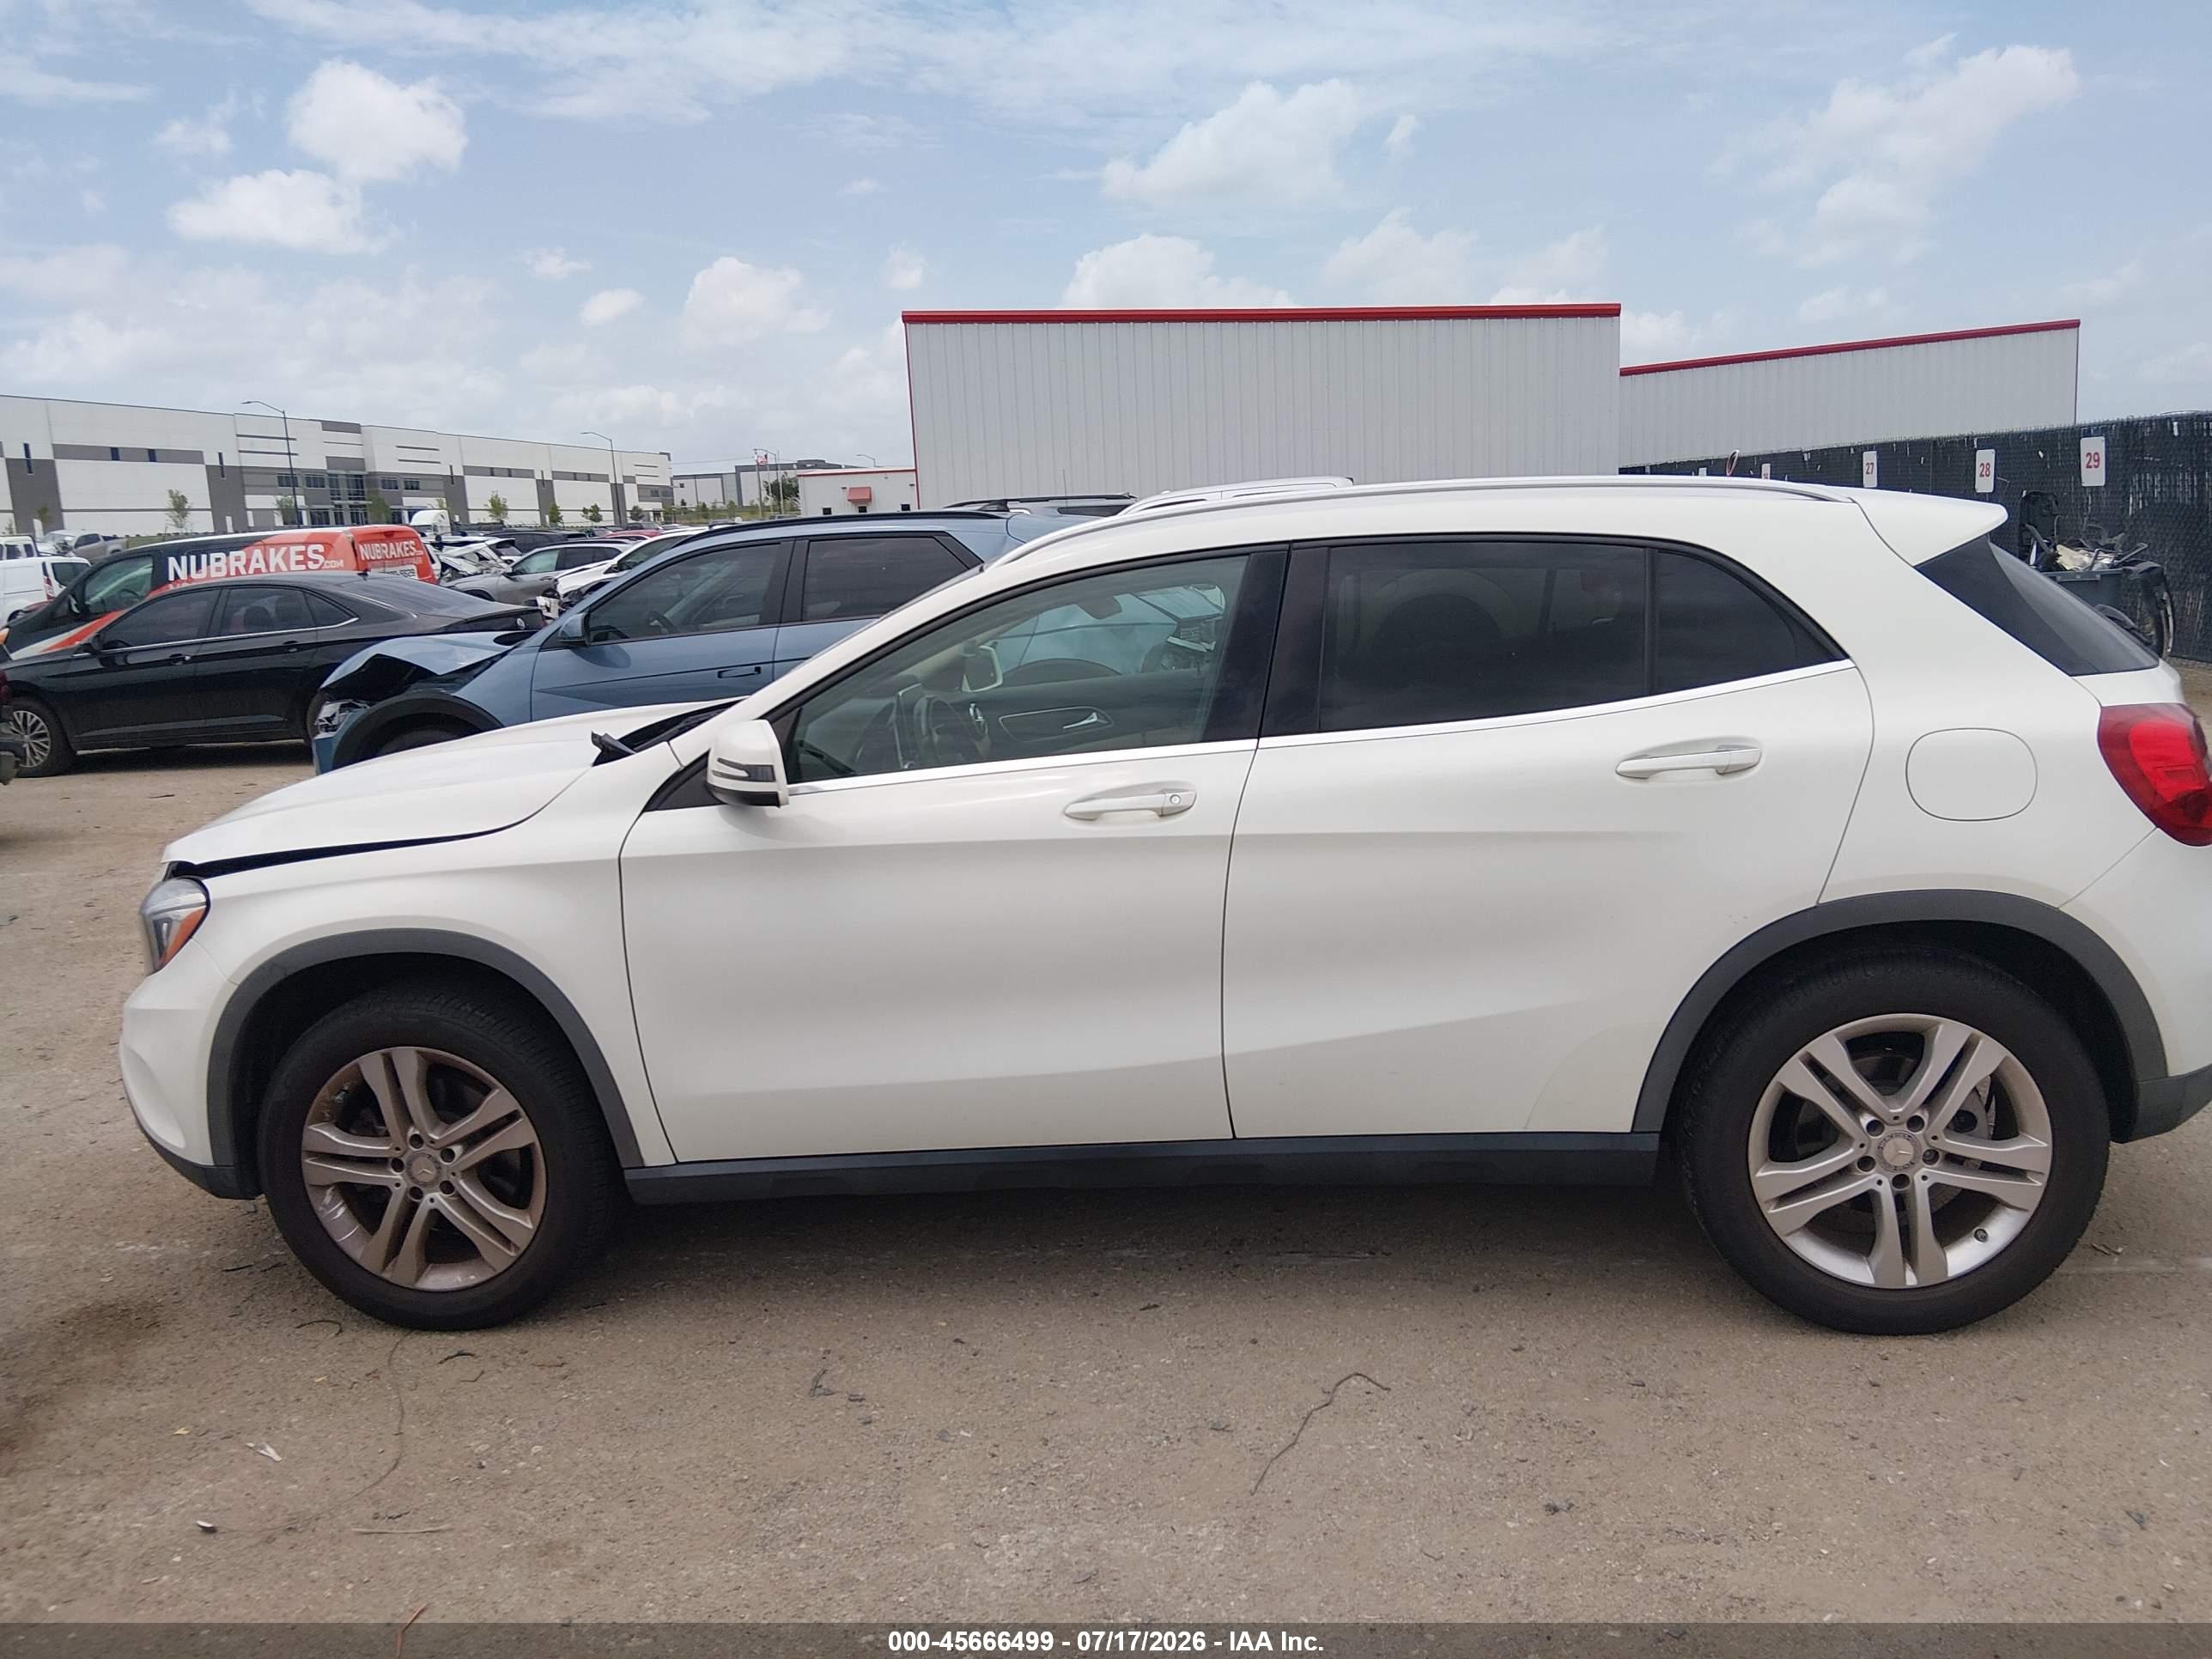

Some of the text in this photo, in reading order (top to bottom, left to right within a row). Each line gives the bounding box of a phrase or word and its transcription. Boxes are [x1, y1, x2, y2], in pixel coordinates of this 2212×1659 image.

[1865, 462, 1875, 475] 27
[2086, 452, 2100, 469] 29
[1979, 462, 1991, 477] 28
[359, 540, 424, 560] NUBRAKES
[167, 544, 343, 581] NUBRAKES.COM
